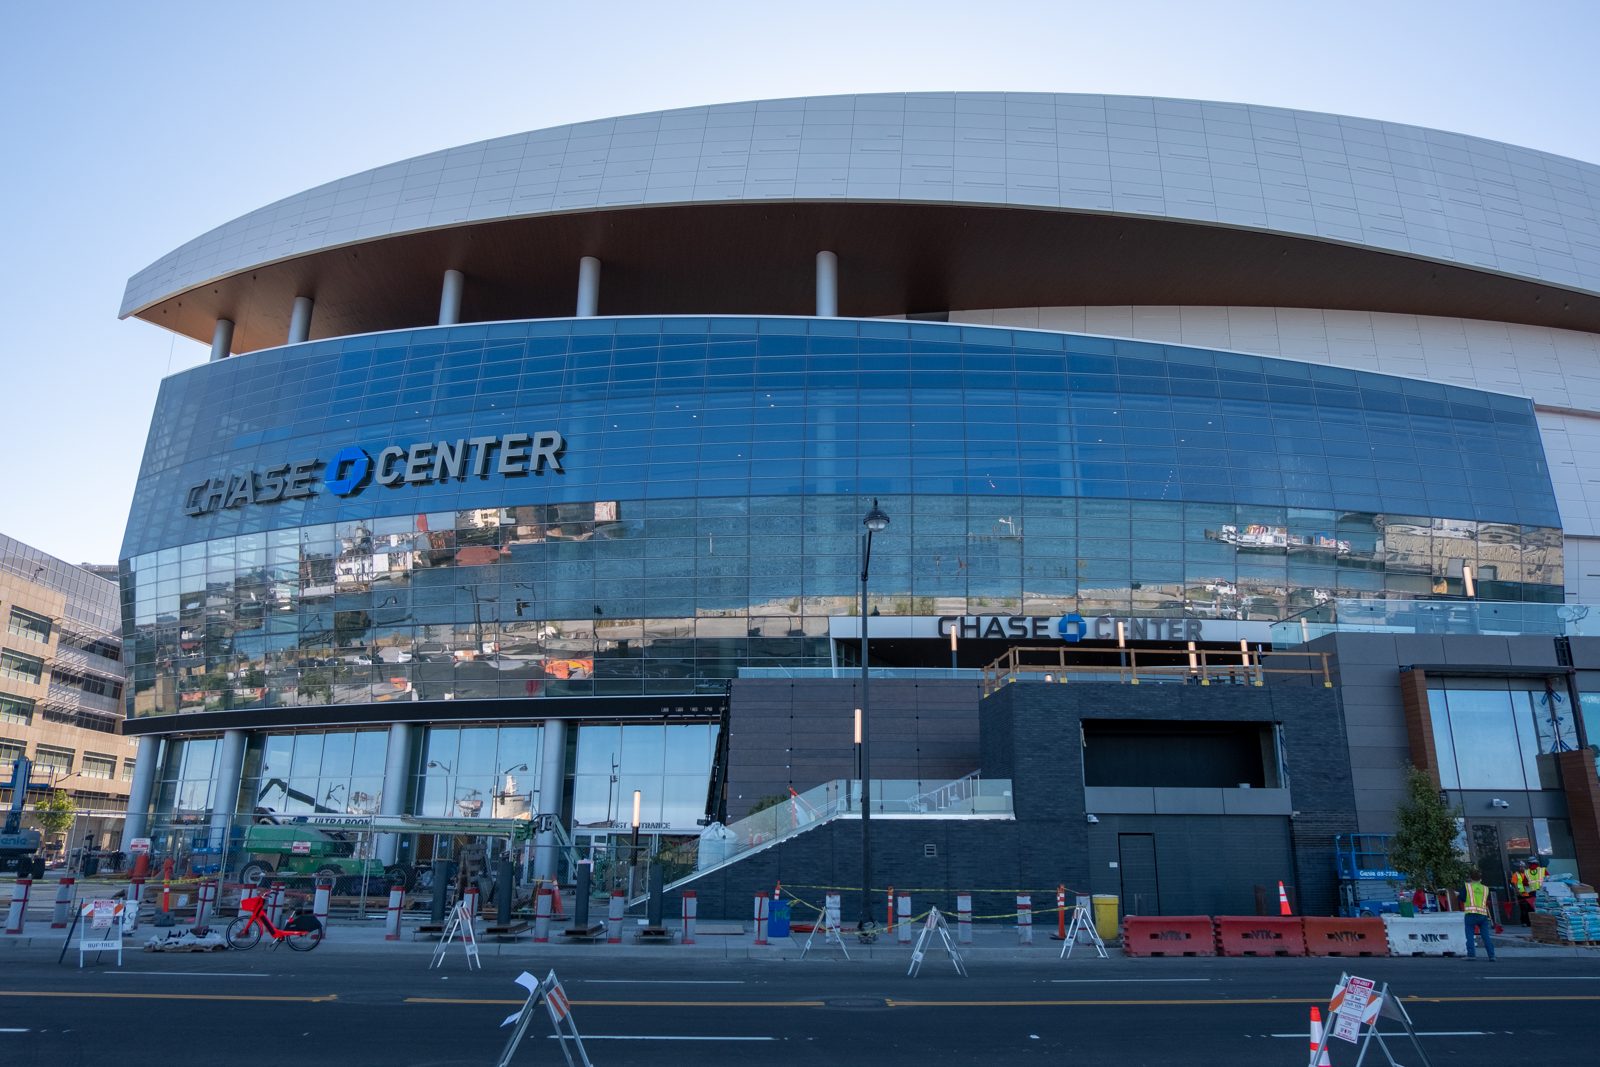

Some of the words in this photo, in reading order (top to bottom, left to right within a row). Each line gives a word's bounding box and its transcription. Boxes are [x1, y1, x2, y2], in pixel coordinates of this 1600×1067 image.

[184, 458, 321, 516] CHASE
[375, 430, 565, 487] CENTER
[938, 616, 1051, 639] CHASE
[1095, 617, 1203, 641] CENTER
[1160, 931, 1183, 941] NTK
[1250, 930, 1273, 940] NTK
[1335, 931, 1359, 942] NTK
[1420, 933, 1440, 943] NTK
